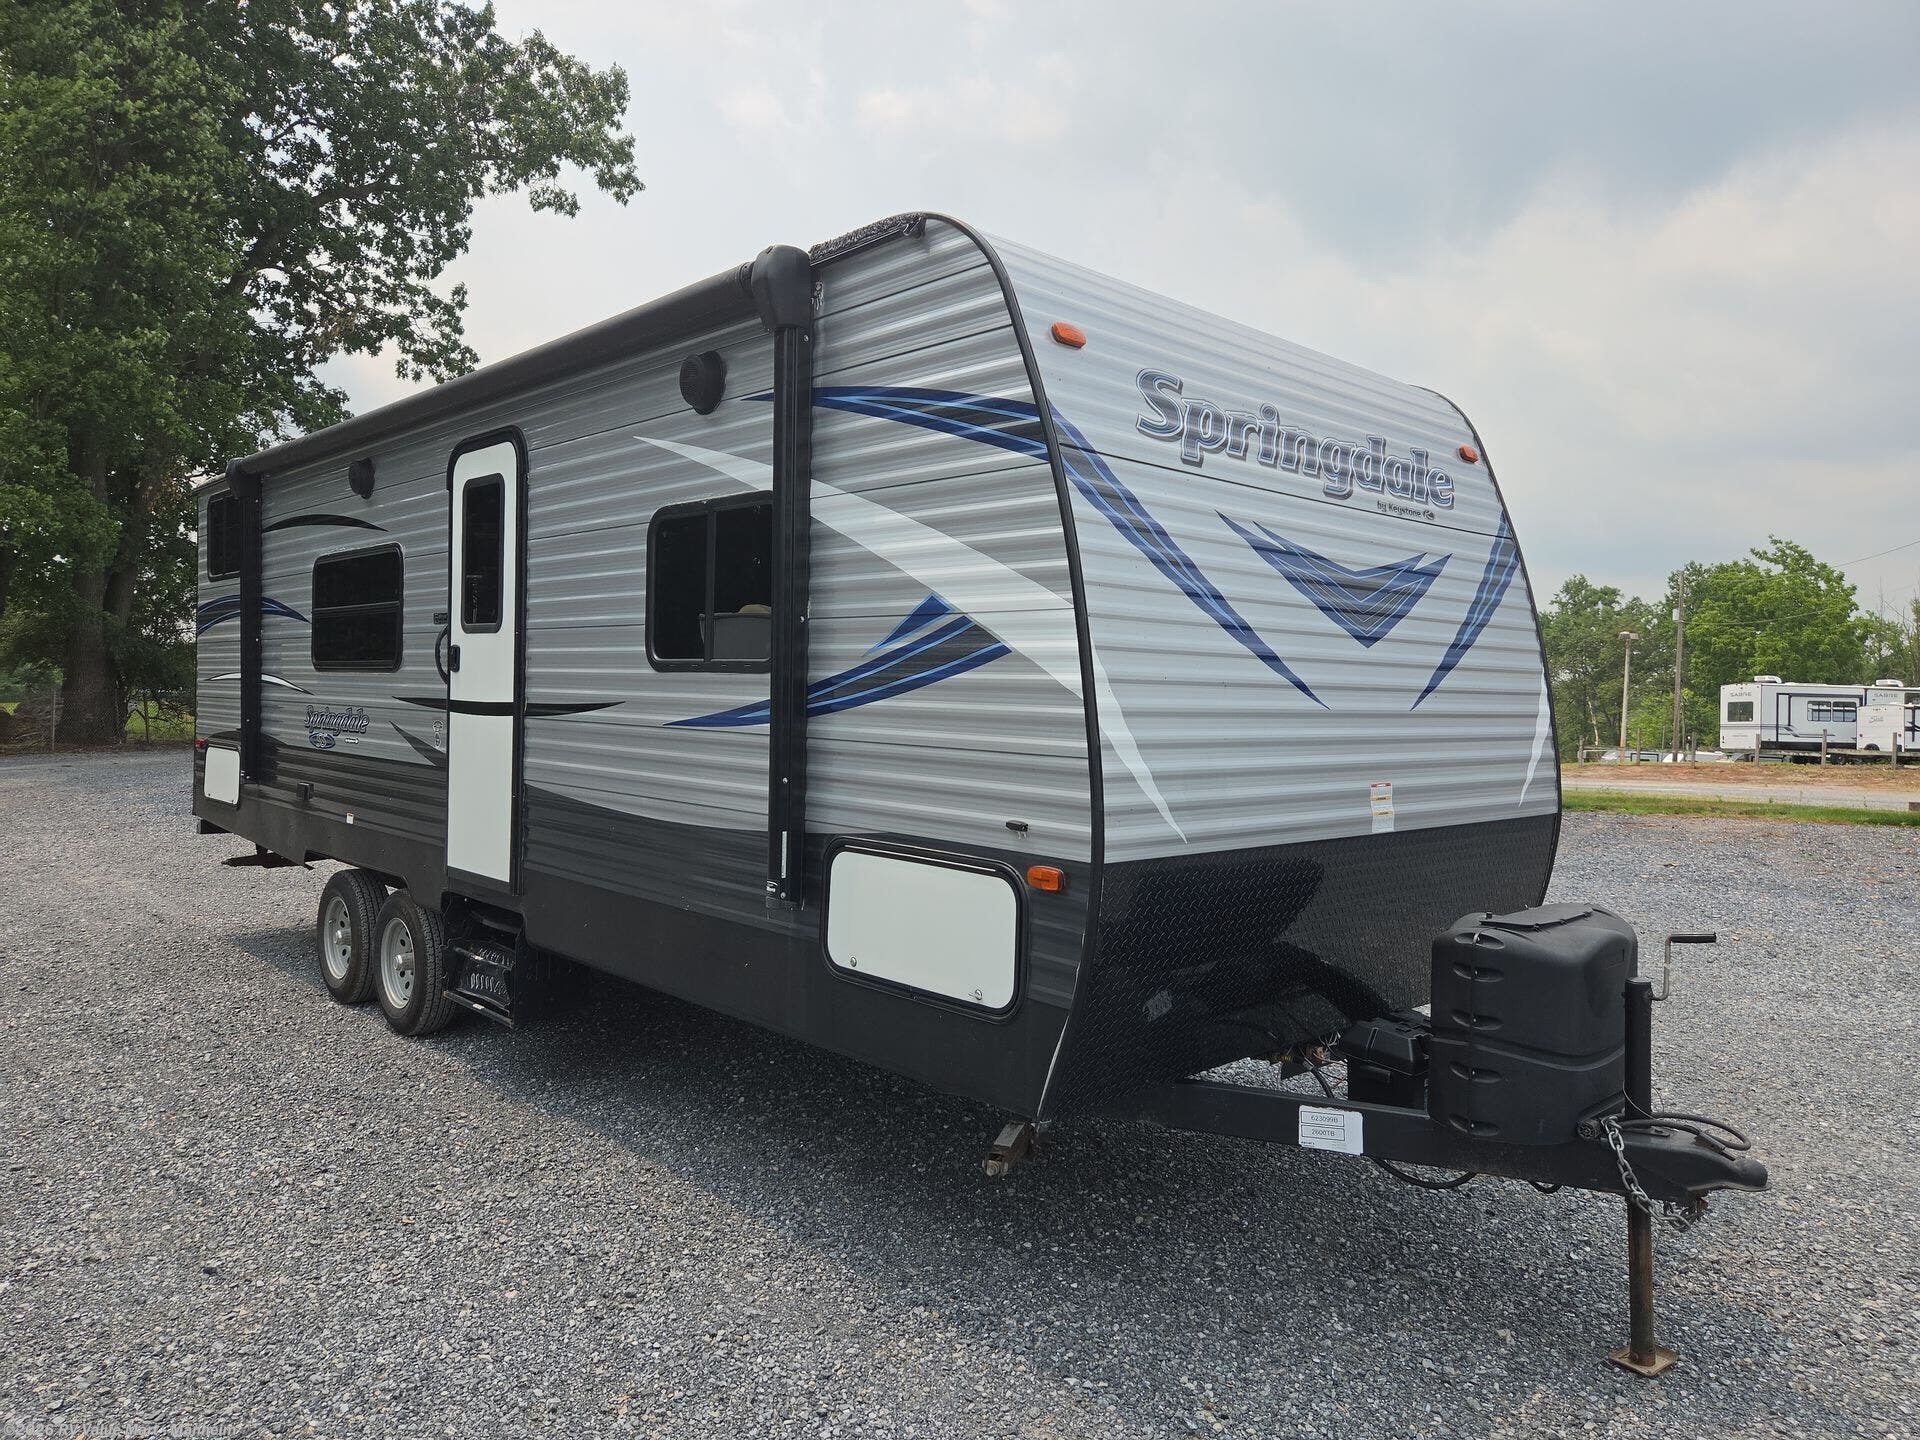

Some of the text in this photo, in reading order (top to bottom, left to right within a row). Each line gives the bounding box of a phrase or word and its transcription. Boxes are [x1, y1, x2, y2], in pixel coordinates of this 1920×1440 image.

[1136, 367, 1455, 510] Springdale
[1389, 503, 1421, 516] Keystone
[304, 704, 370, 736] Springdale
